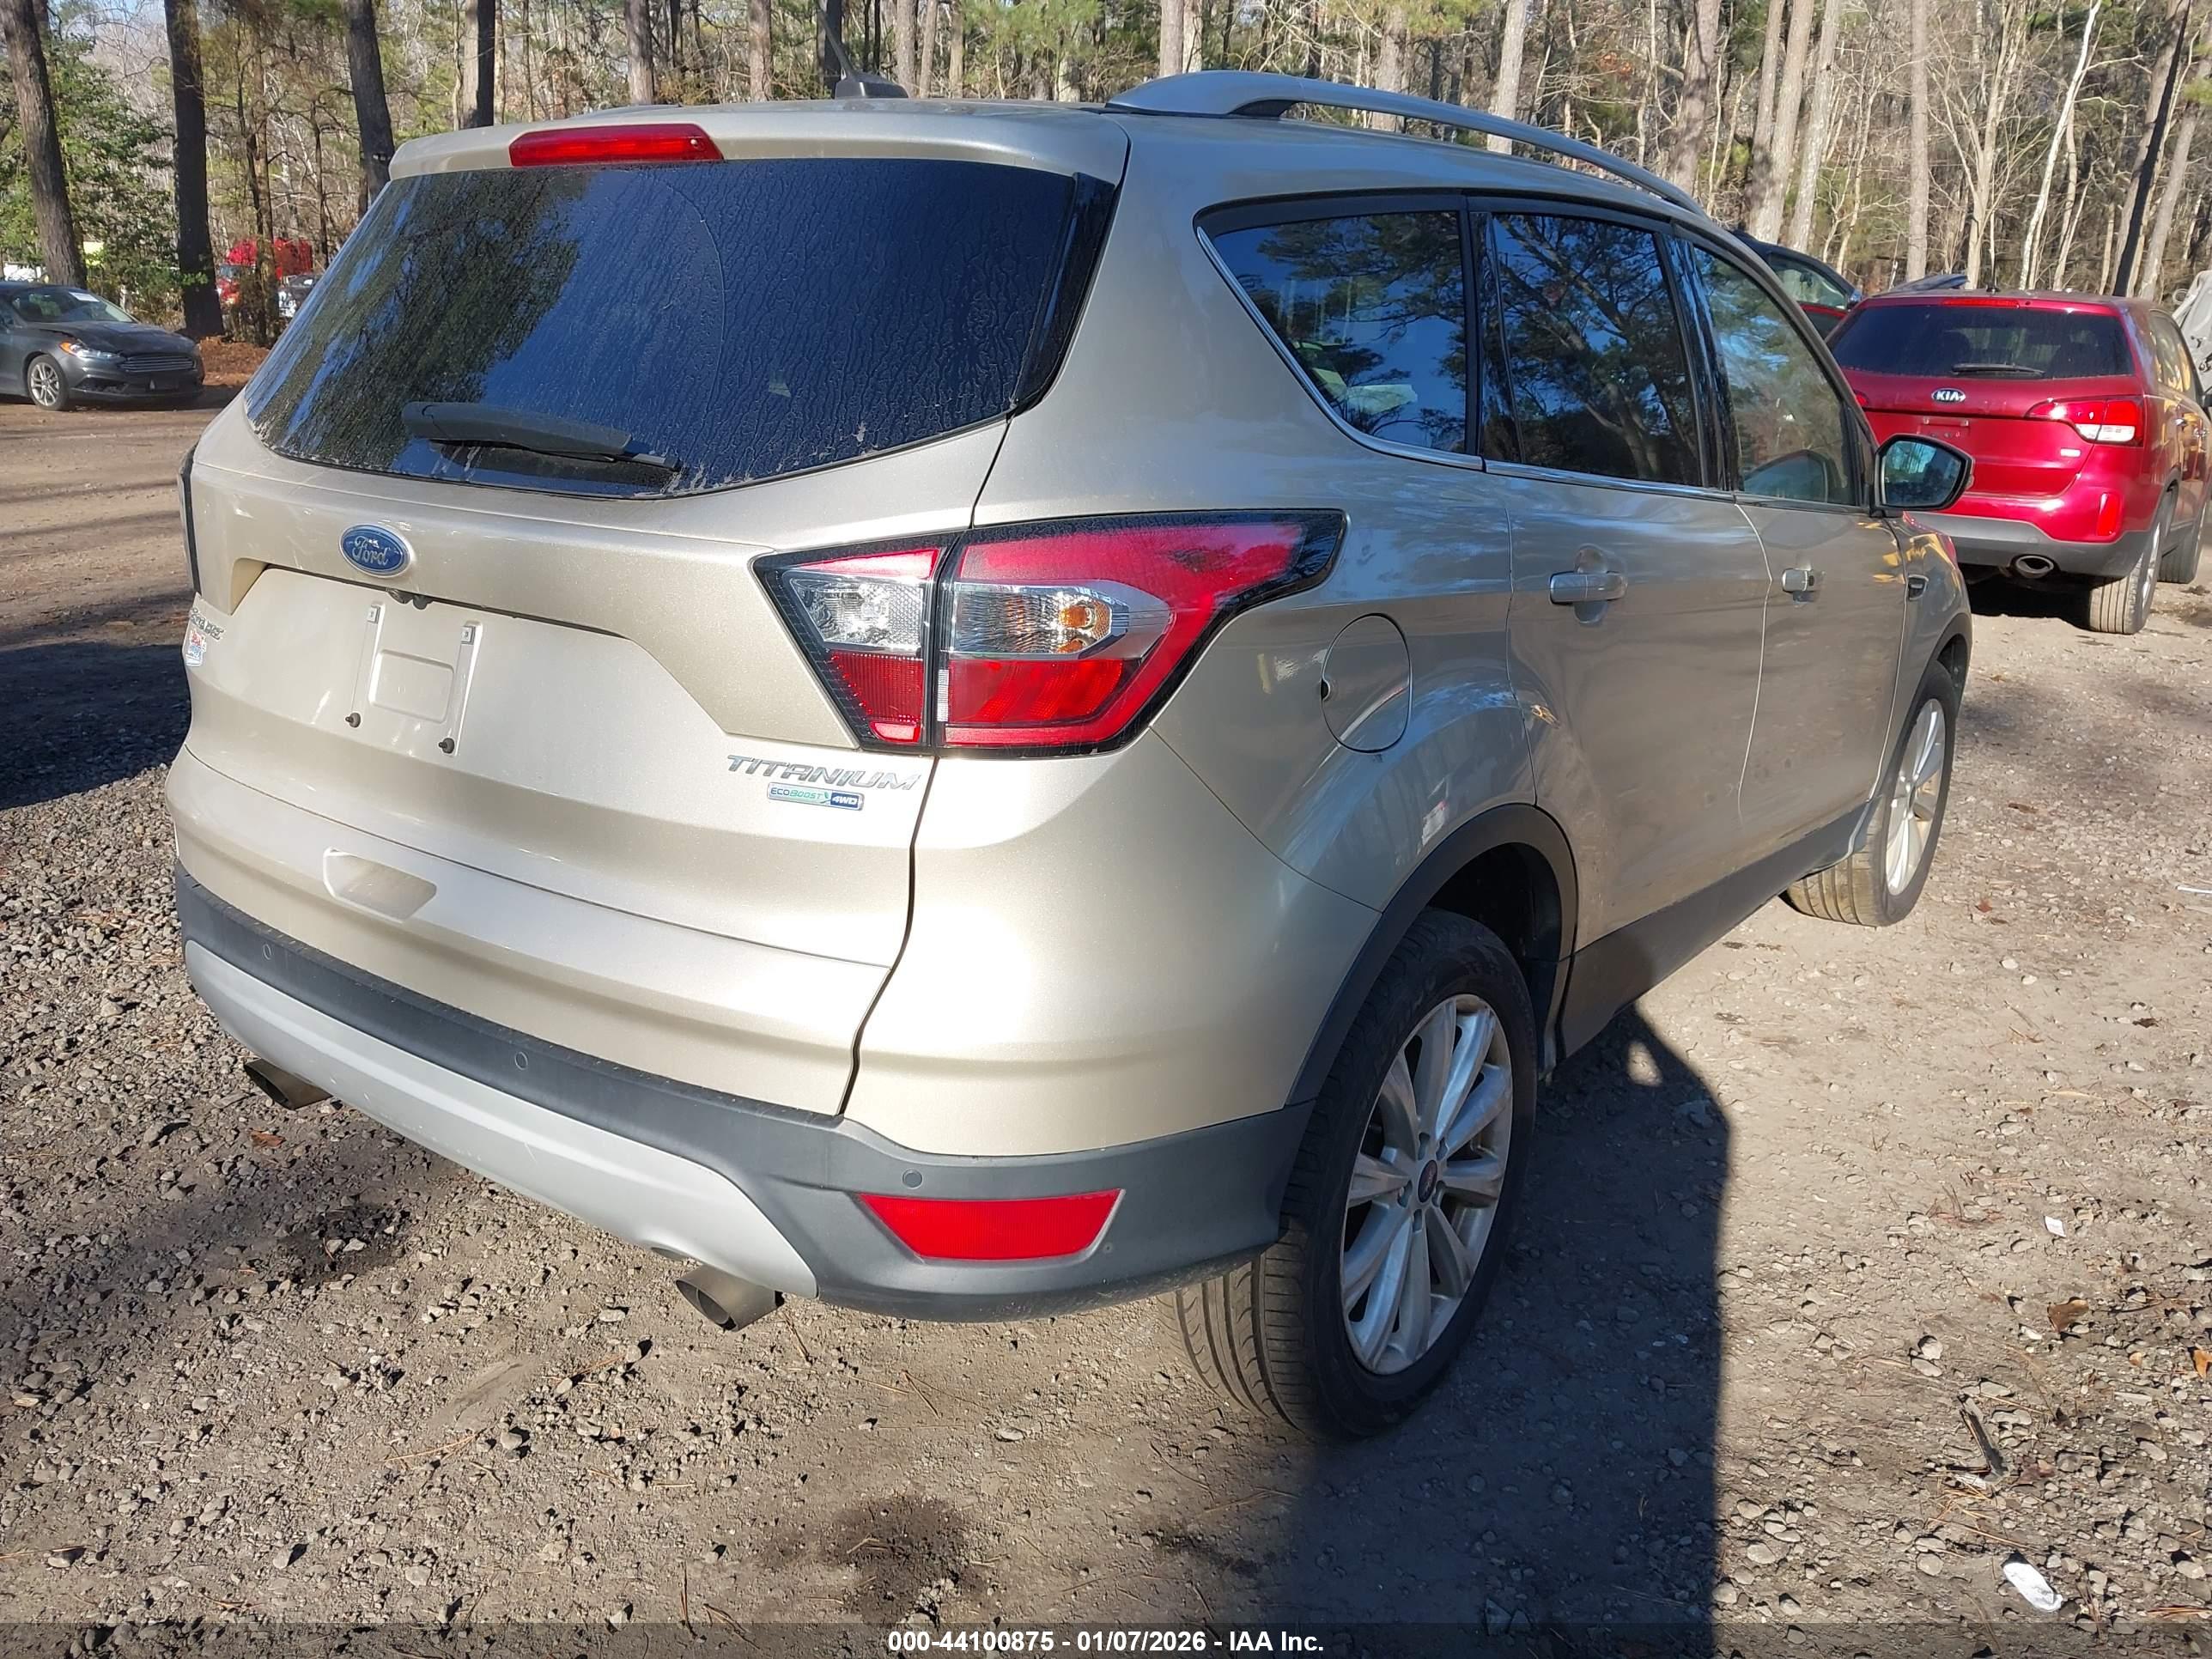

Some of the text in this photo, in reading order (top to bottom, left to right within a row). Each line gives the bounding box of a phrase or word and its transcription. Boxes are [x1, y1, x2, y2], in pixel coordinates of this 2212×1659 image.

[1936, 391, 1959, 401] KIA
[352, 535, 390, 566] Ford
[727, 754, 921, 790] TITANIUM
[831, 795, 857, 805] 4WD
